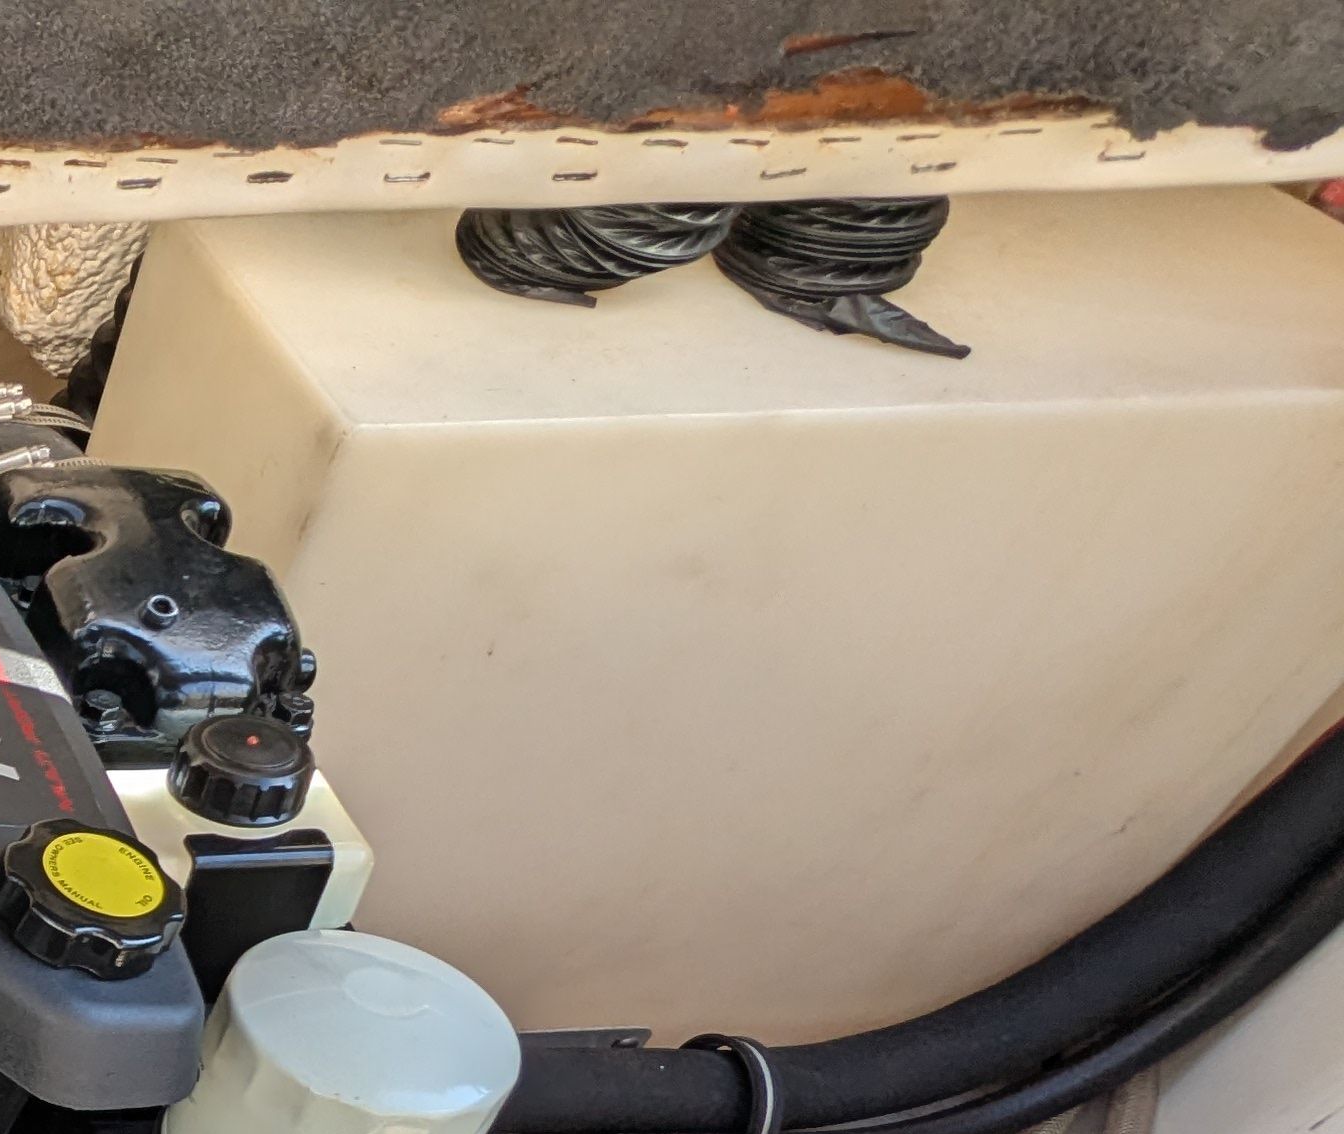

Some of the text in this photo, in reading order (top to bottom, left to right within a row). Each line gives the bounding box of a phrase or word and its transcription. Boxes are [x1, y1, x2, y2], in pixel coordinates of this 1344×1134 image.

[63, 836, 84, 846] SEE
[118, 846, 155, 907] ENGINE OIL
[57, 879, 104, 910] MANUAL
